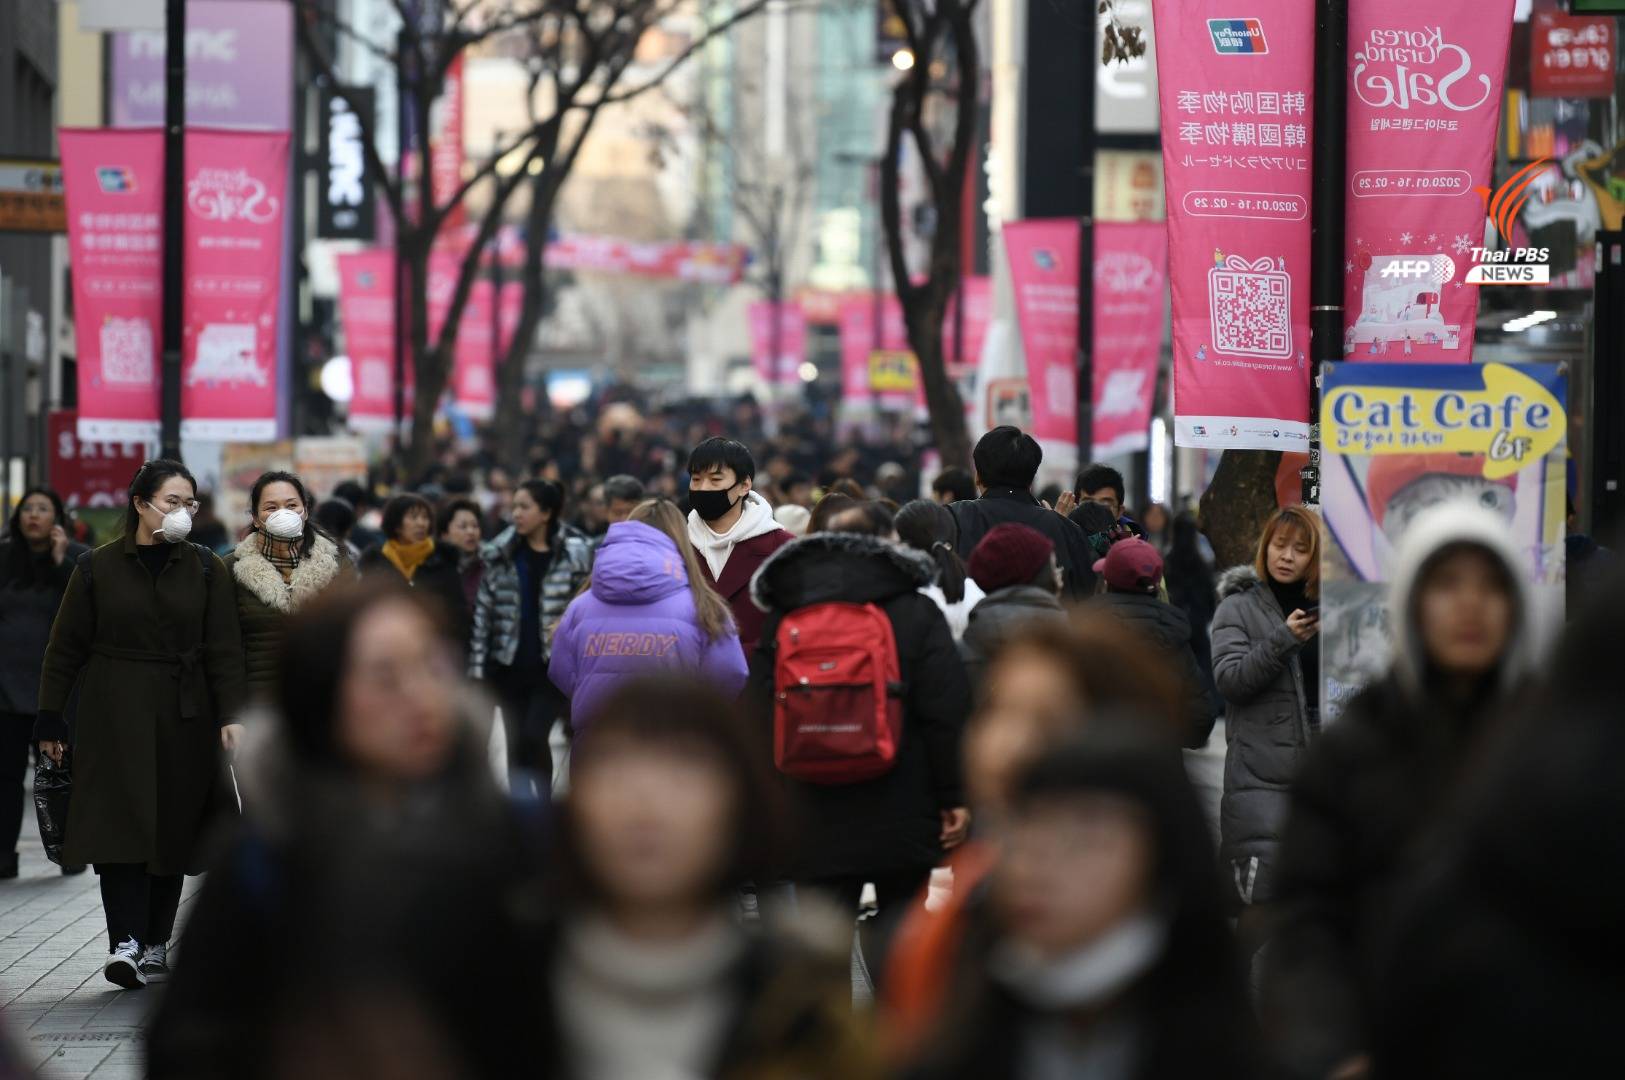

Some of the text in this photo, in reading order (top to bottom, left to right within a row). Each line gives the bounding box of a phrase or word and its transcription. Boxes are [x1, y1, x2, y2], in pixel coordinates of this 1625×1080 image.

[1333, 391, 1551, 430] Cat Cafe
[1489, 430, 1533, 462] 6F
[584, 632, 679, 657] NERDY
